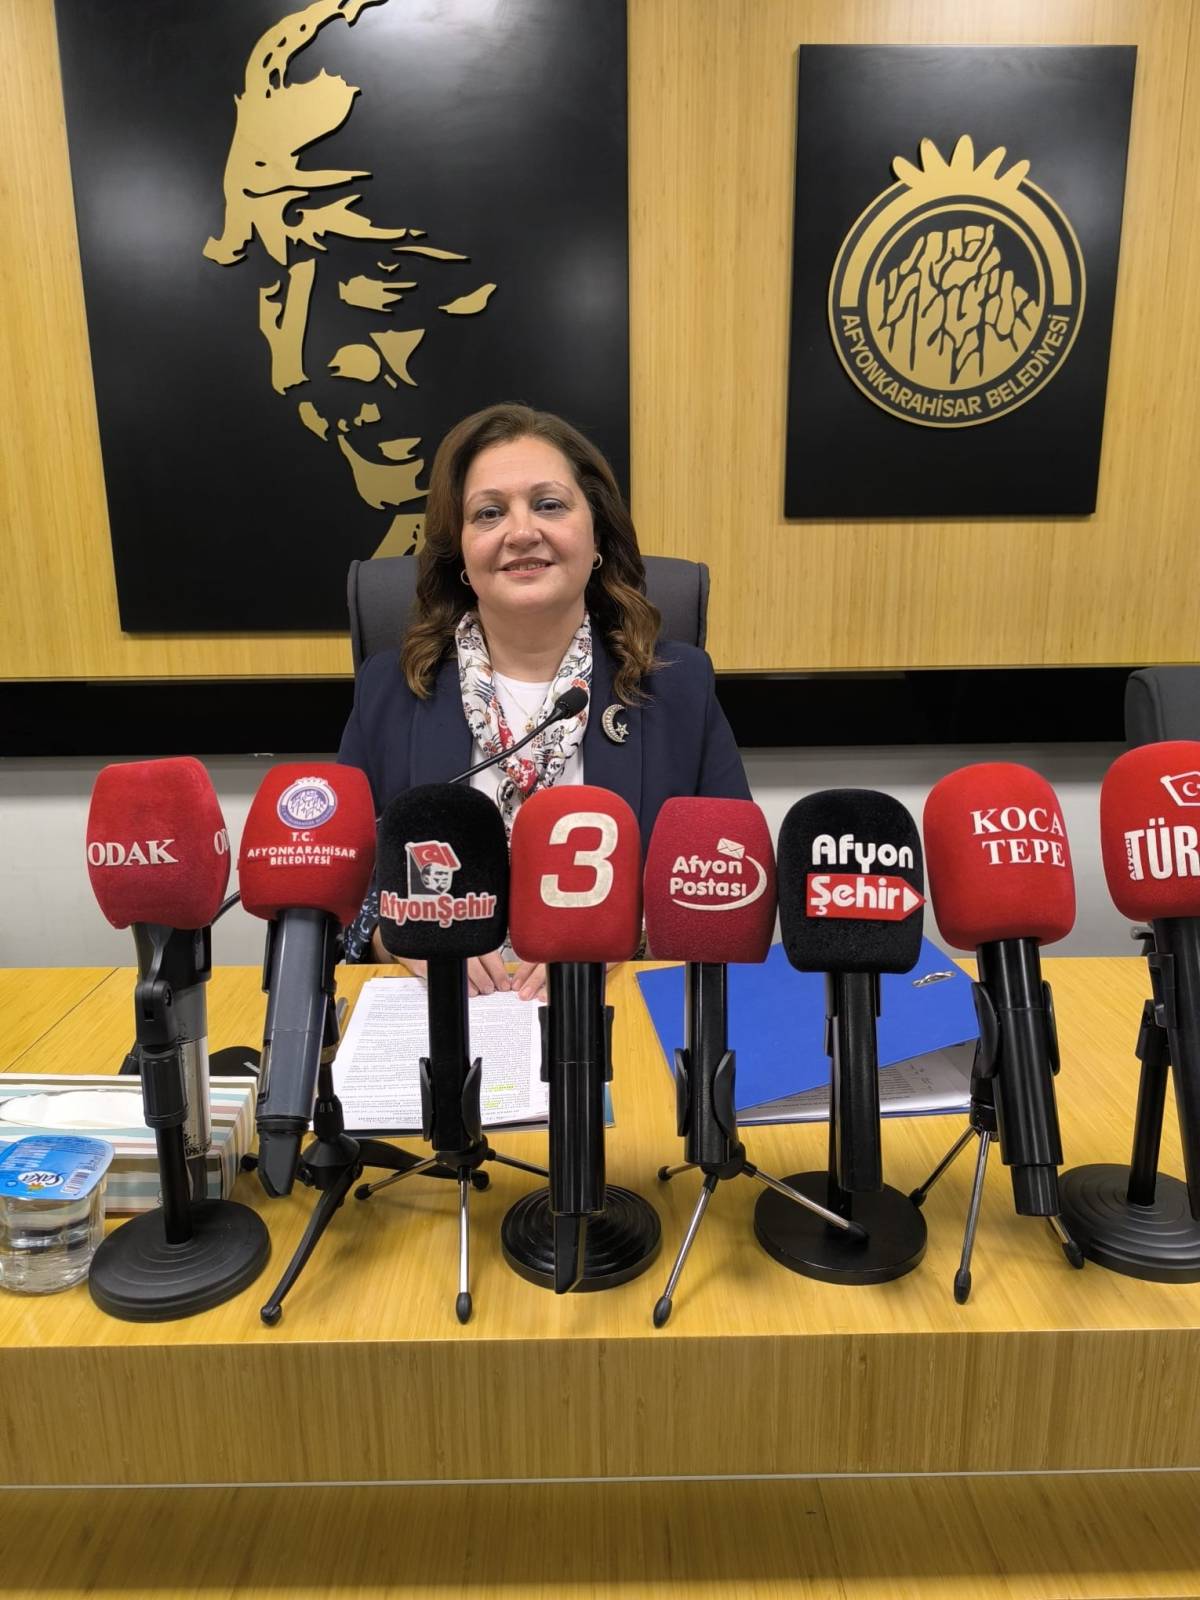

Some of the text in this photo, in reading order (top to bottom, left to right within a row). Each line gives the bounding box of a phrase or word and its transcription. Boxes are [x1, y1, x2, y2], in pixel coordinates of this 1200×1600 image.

[841, 313, 1071, 418] AFYONKARAHİSAR BELEDİYESİ
[291, 831, 314, 842] T.C.
[969, 806, 1065, 837] KOCA
[87, 838, 179, 867] ODAK
[247, 845, 356, 858] AFYONKARAHİSAR
[270, 855, 331, 866] BELEDİYESİ
[539, 811, 619, 909] 3
[812, 833, 914, 874] Afyon
[981, 838, 1066, 867] TEPE
[1123, 816, 1200, 881] TÜR
[672, 855, 743, 878] Afyon
[669, 877, 747, 897] Postası
[809, 875, 901, 915] Şehir
[379, 890, 497, 928] AfyonŞehir
